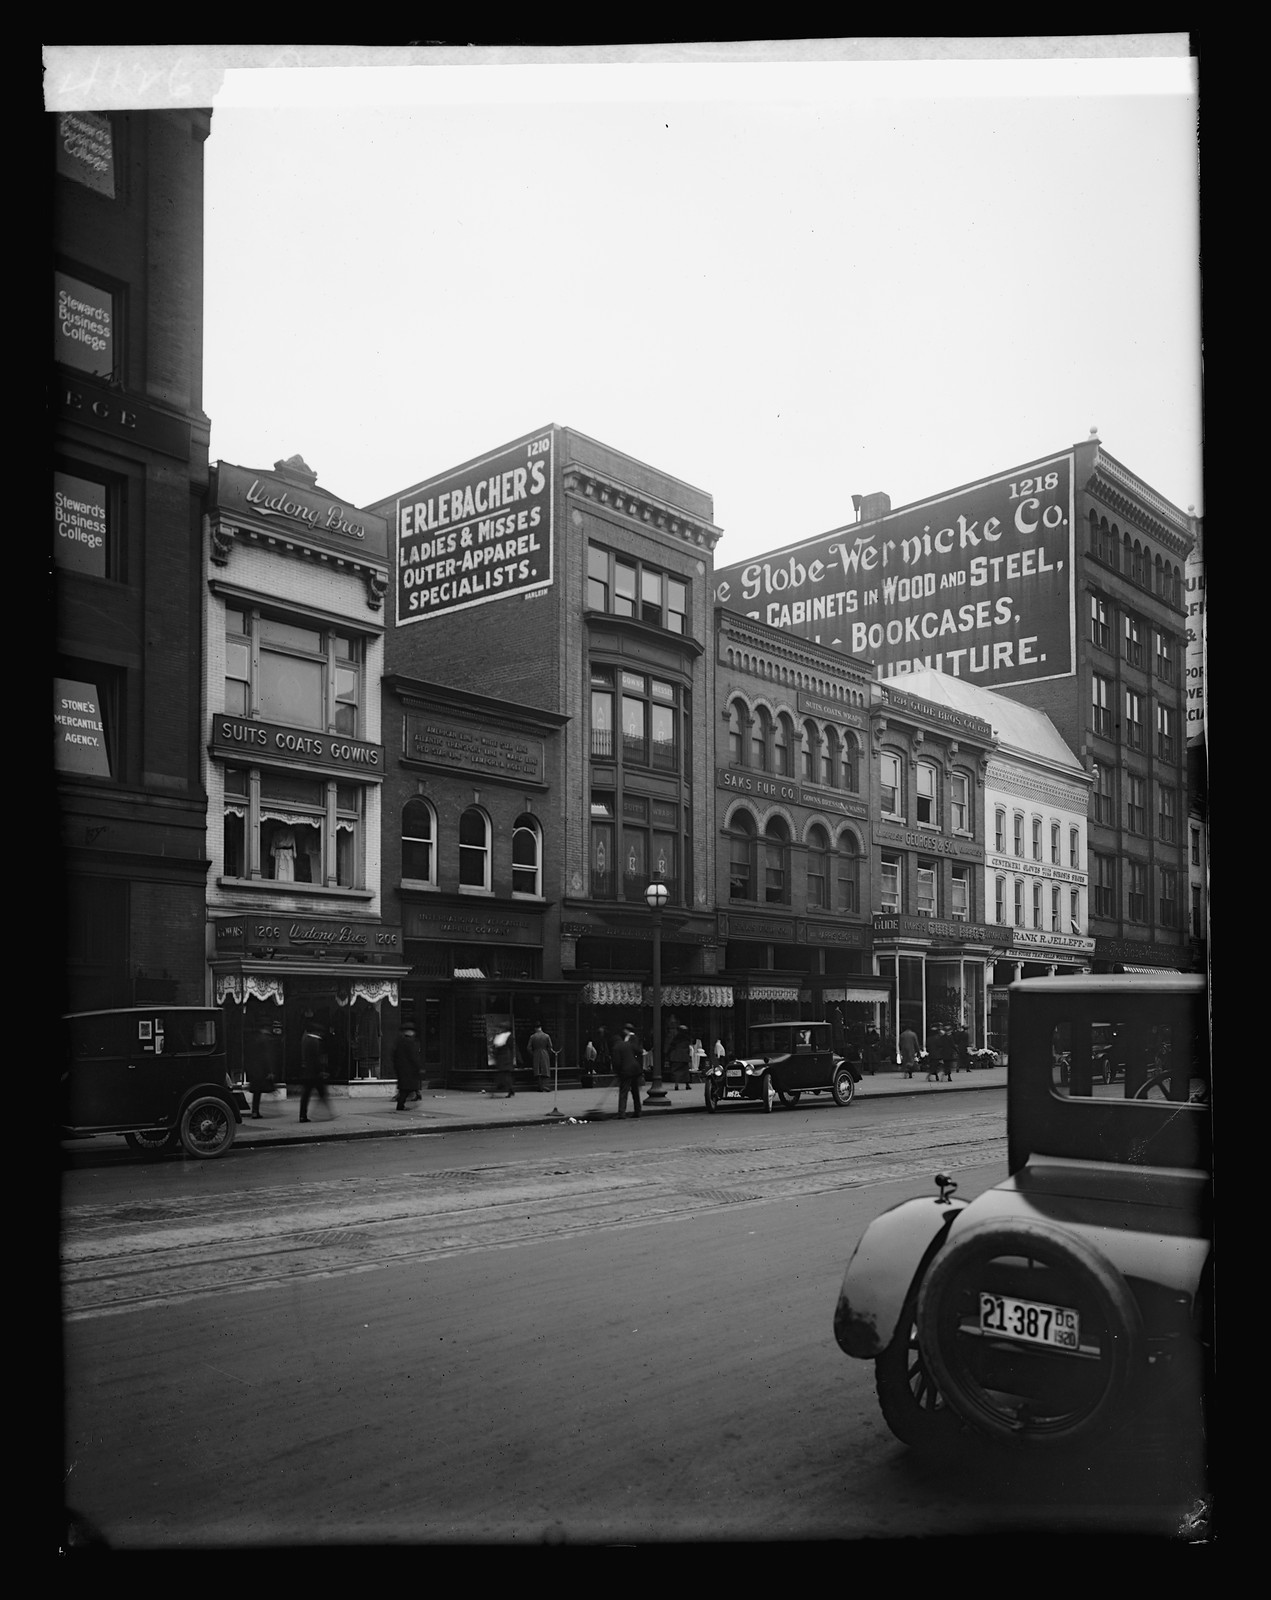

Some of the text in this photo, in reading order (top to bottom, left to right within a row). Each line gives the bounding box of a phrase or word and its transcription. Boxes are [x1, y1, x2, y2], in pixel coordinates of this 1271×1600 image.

[63, 139, 109, 171] College
[58, 290, 110, 323] Steward's
[58, 304, 111, 338] Business
[62, 321, 107, 351] College
[527, 438, 550, 457] 1210
[400, 460, 546, 538] ERLEBACHER'S
[1009, 472, 1059, 500] 1218
[55, 492, 106, 519] Steward's
[55, 506, 107, 534] Business
[325, 504, 366, 540] Bros
[58, 522, 103, 548] College
[400, 506, 542, 567] LADIES & MISSES
[741, 498, 1069, 600] Globe-Wernicke Co.
[403, 533, 542, 588] OUTER-APPAREL
[408, 559, 537, 611] SPECIALISTS.
[766, 589, 858, 628] CABINETS
[863, 588, 878, 606] IN
[883, 572, 936, 606] WOOD
[939, 570, 966, 590] AND
[969, 546, 1064, 587] STEEL,
[852, 596, 1020, 653] BOOKCASES,
[61, 699, 96, 714] STONE'S
[805, 700, 823, 711] SUITS
[823, 706, 842, 717] COATS
[910, 701, 936, 716] GUDE
[938, 710, 961, 725] BROS
[54, 714, 104, 732] MERCANTILE
[64, 733, 99, 747] AGENCY.
[222, 723, 379, 765] SUITS COATS GOWNS
[724, 773, 752, 790] SAKS
[757, 782, 776, 796] FUR
[905, 832, 936, 851] GEORGES
[1023, 864, 1041, 874] GLOVES
[255, 925, 280, 938] 1206
[376, 933, 398, 945] 1206
[874, 920, 898, 930] GUDE
[1013, 932, 1037, 943] RANK
[983, 1298, 1075, 1340] 21-387 DC
